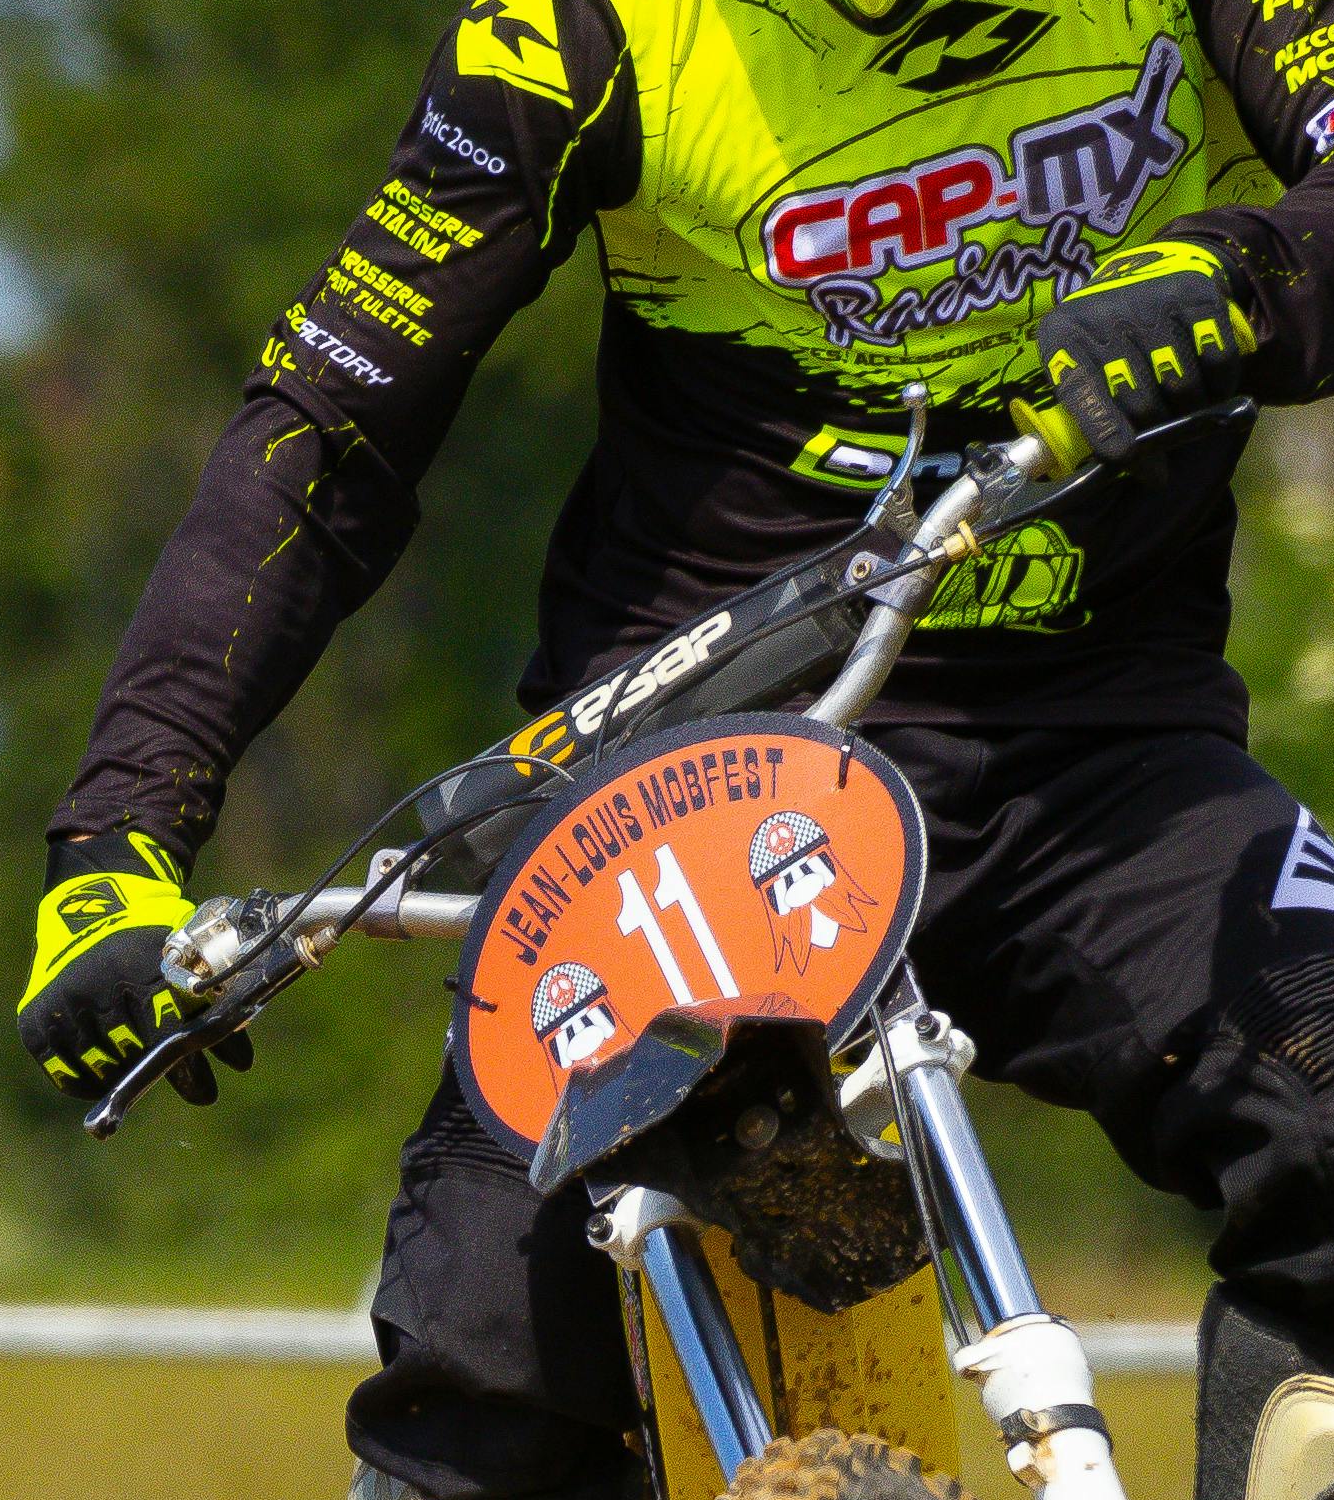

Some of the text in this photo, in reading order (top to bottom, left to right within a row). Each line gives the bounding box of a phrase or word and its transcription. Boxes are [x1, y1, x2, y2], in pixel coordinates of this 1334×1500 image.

[367, 200, 452, 263] ATALINA
[383, 180, 484, 248] ROSSERIE
[340, 247, 433, 317] ROSSERIE
[810, 213, 1096, 347] Racing
[353, 288, 432, 346] TULETTE
[501, 747, 784, 966] JEAN-LOUIS MOBFEST
[616, 842, 741, 1006] 11
